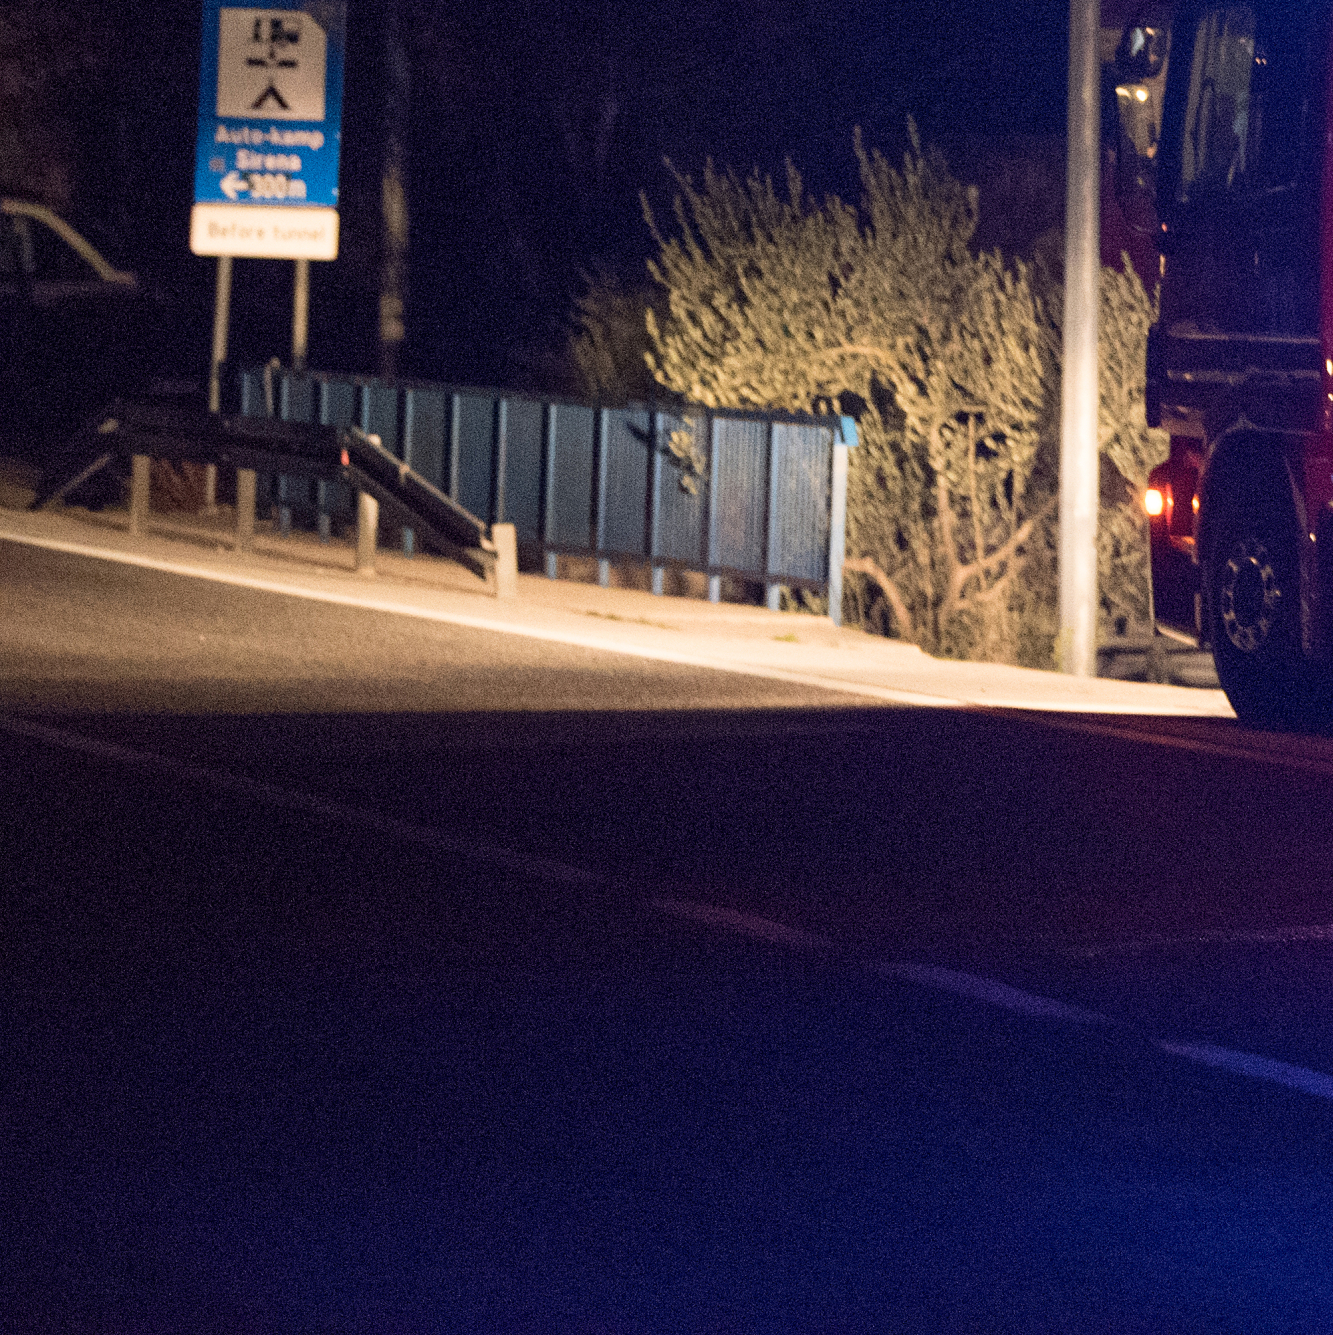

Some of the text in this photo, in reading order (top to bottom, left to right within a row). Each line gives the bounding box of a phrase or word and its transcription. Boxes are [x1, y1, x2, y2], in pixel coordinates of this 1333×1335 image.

[215, 125, 325, 151] Auto-kamp
[236, 149, 302, 171] Sirena
[207, 220, 326, 242] Before tunnel
